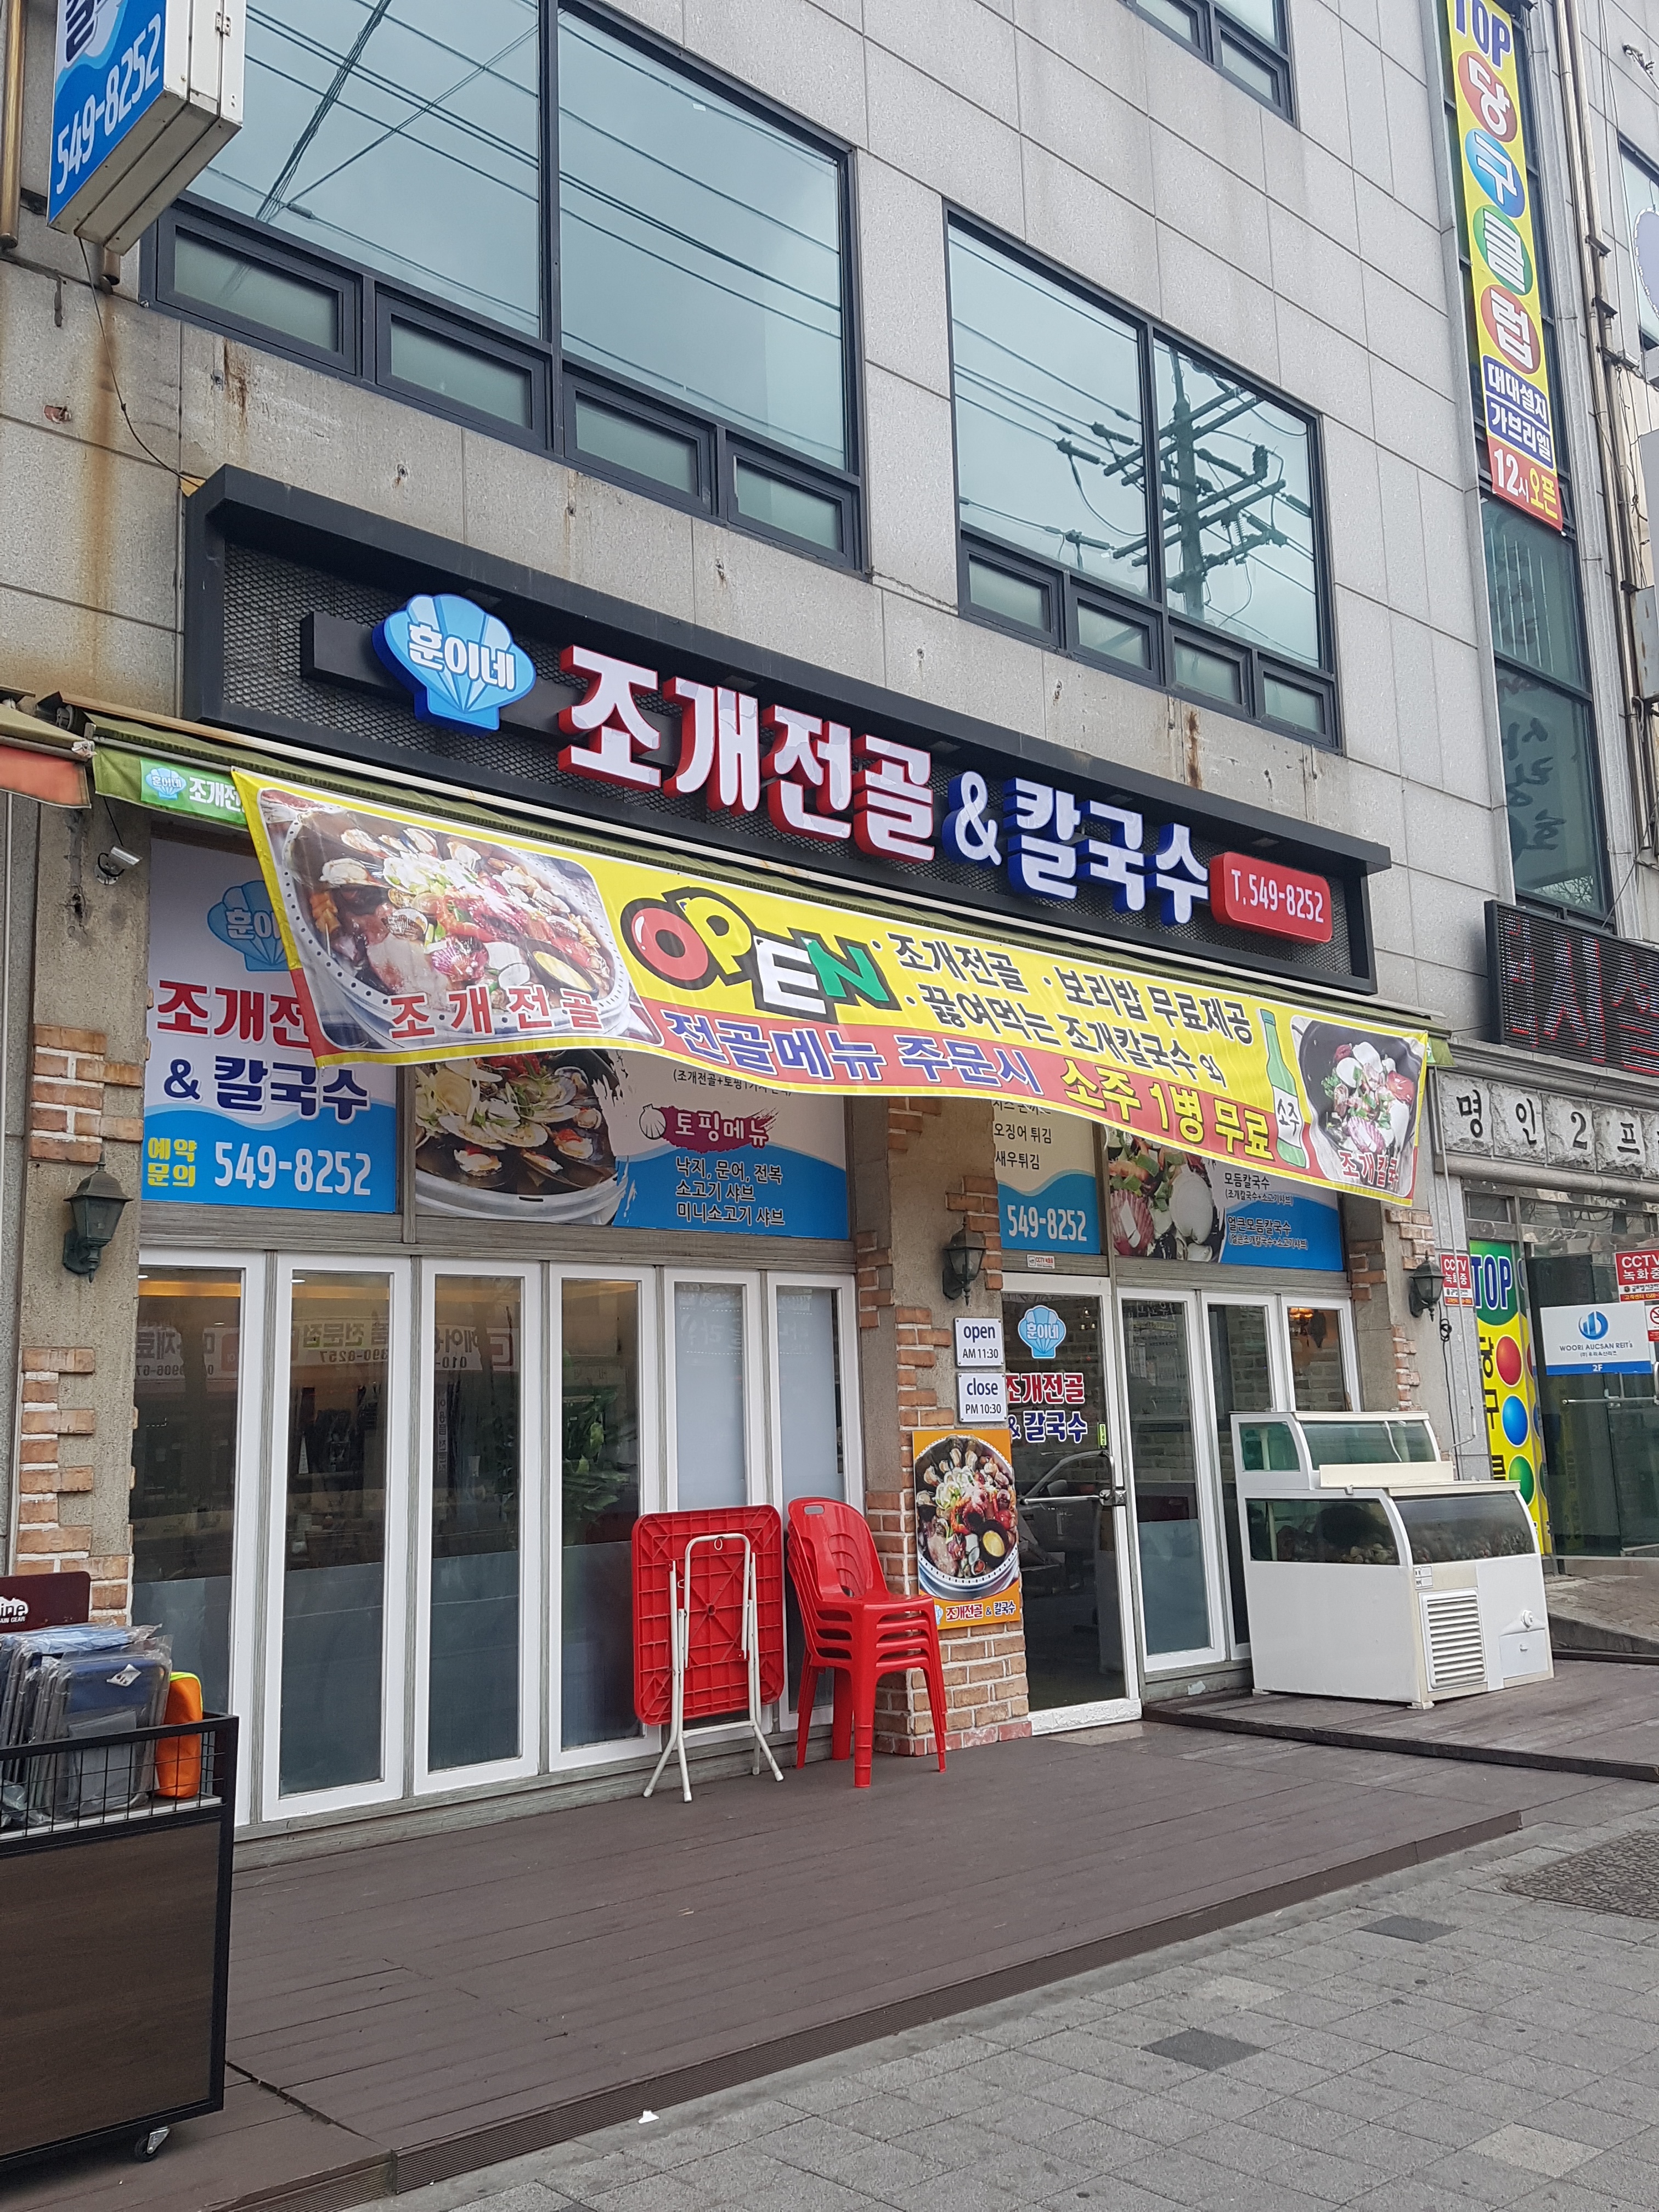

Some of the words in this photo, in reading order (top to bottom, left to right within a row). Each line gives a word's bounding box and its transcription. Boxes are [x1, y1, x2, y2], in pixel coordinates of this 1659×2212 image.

[56, 13, 161, 195] 549-8252
[1487, 362, 1548, 424] 대대설치
[1490, 402, 1551, 462] 가브리엘
[1494, 448, 1529, 503] 12시
[1529, 467, 1559, 521] 오픈
[408, 622, 516, 691] 훈이네
[151, 775, 182, 788] 훈이네
[189, 776, 246, 813] 조개전
[558, 644, 934, 862] 조개전골
[943, 771, 1002, 868] &
[1003, 777, 1209, 925] 칼국수
[1231, 869, 1324, 923] T.549-8252
[225, 907, 281, 940] 훈이
[620, 886, 903, 1024] OPEN
[888, 932, 1030, 994] 조개전골
[157, 980, 312, 1049] 조개전
[390, 985, 602, 1039] 조개전골
[1053, 966, 1148, 1022] 보리밥
[1146, 985, 1254, 1045] 무료제공
[918, 983, 1062, 1046] 끓여먹는
[1057, 1013, 1198, 1080] 조개칼국수
[163, 1059, 201, 1101] &
[214, 1055, 368, 1121] 칼국수
[660, 1008, 888, 1081] 전골메뉴
[894, 1034, 1044, 1096] 주문시
[1060, 1058, 1142, 1122] 소주
[1149, 1081, 1204, 1144] 1병
[1214, 1098, 1276, 1161] 무료
[674, 1112, 768, 1146] 토핑메뉴
[994, 1122, 1028, 1142] 오징어
[1030, 1127, 1052, 1144] 튀김
[1277, 1098, 1301, 1136] 소주
[1456, 1089, 1659, 1155] 명인2프
[148, 1137, 198, 1159] 예약
[995, 1150, 1040, 1170] 새우튀김
[147, 1163, 196, 1188] 문의
[214, 1142, 372, 1195] 549-8252
[675, 1156, 713, 1180] 낙지,
[715, 1160, 751, 1182] 문어,
[753, 1164, 783, 1185] 전복
[1224, 1172, 1270, 1190] 모듬칼국수
[1338, 1150, 1399, 1189] 조개칼국
[675, 1180, 721, 1201] 소고기
[726, 1184, 755, 1203] 샤브
[677, 1201, 752, 1226] 미니소고기
[756, 1207, 785, 1227] 샤브
[1007, 1204, 1087, 1242] 549-8252
[1228, 1216, 1291, 1235] 얼큰모듬칼국수
[1470, 1254, 1513, 1311] TOP
[963, 1325, 996, 1342] open
[1026, 1323, 1059, 1340] 훈이네
[963, 1349, 976, 1358] AM
[978, 1348, 998, 1359] 11:30
[967, 1378, 998, 1395] close
[1006, 1373, 1085, 1404] 조개전골
[966, 1404, 978, 1414] PM
[980, 1403, 1001, 1414] 10:30
[1023, 1410, 1088, 1443] 칼국수
[946, 1603, 983, 1621] 조개전골
[985, 1607, 992, 1616] &
[994, 1600, 1016, 1616] 칼국수
